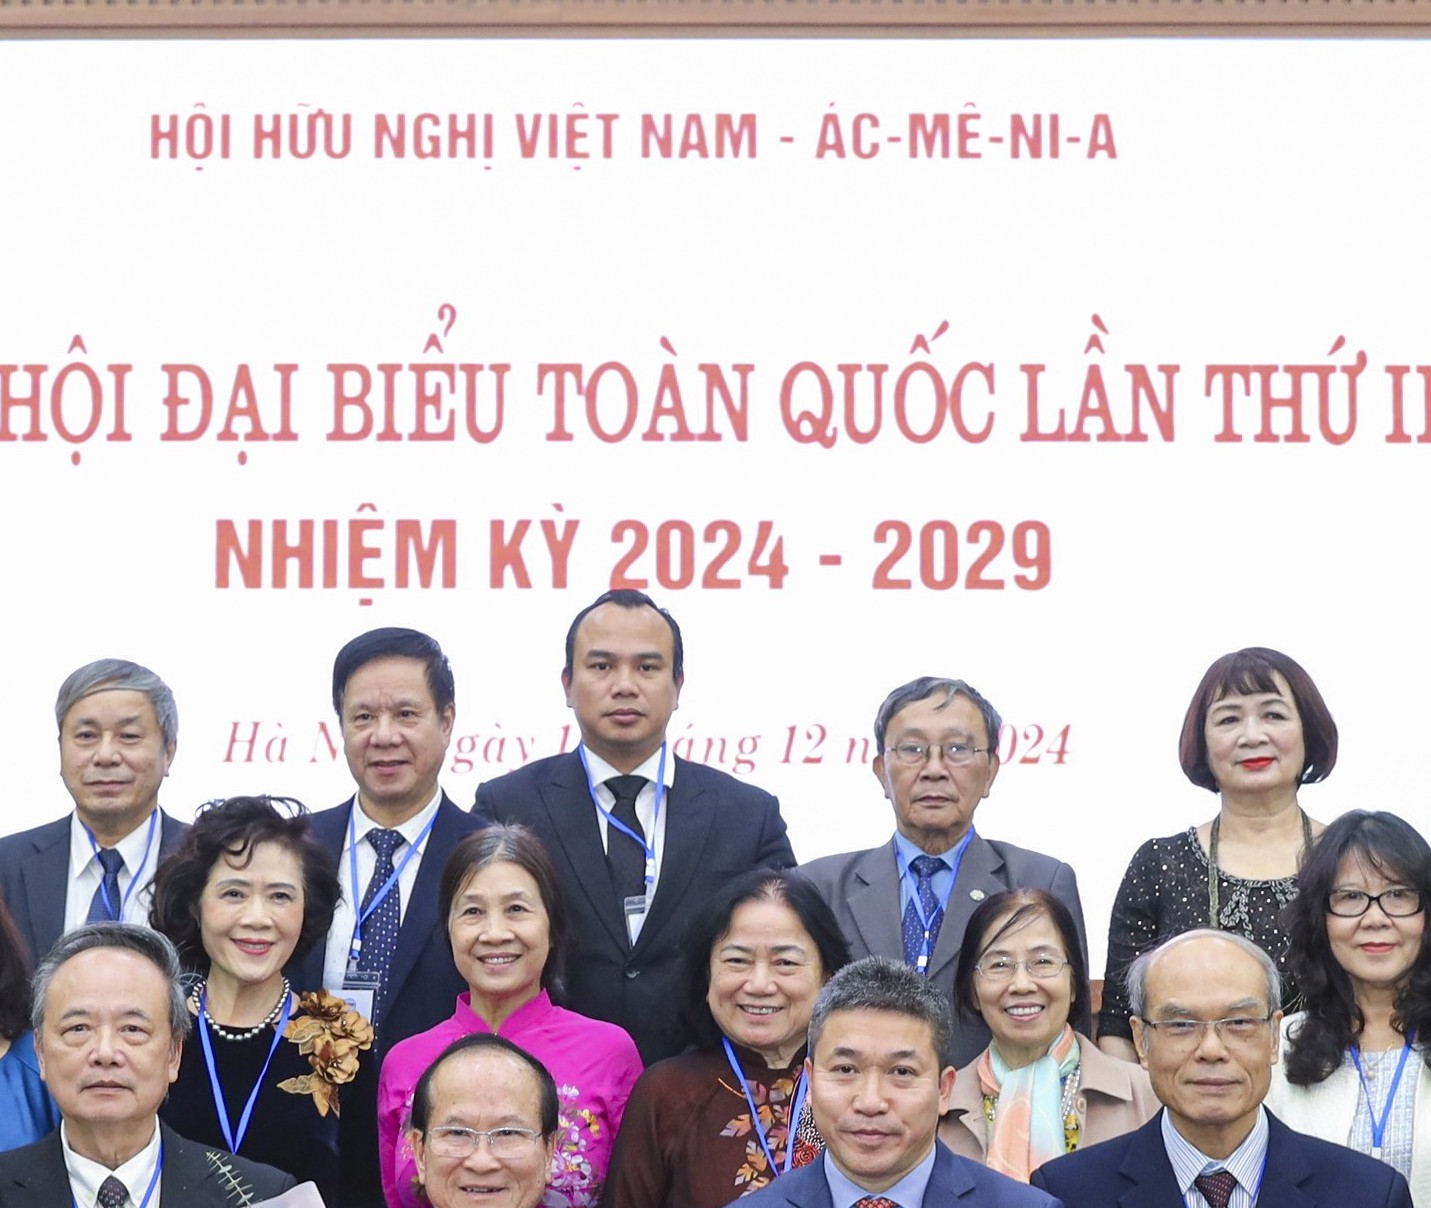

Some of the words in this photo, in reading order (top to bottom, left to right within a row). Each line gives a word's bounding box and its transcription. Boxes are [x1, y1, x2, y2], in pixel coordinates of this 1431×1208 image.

[150, 102, 232, 172] HỘI
[253, 102, 353, 160] HỮU
[374, 112, 494, 171] NGHỊ
[515, 102, 620, 171] VIỆT
[641, 112, 758, 160] NAM
[779, 135, 795, 144] -
[815, 101, 1119, 161] ÁC-MÊ-NI-A
[159, 362, 300, 466] ĐẠI
[326, 302, 512, 445] BIỂU
[536, 335, 756, 445] TOÀN
[778, 319, 996, 450] QUỐC
[1018, 312, 1182, 444] LẦN
[1203, 334, 1369, 447] THỨ
[214, 502, 458, 608] NHIỆM
[489, 502, 581, 590] KỲ
[609, 518, 790, 591] 2024
[818, 553, 843, 567] -
[871, 518, 1053, 592] 2029
[222, 722, 289, 764] Hà
[450, 723, 535, 774] gày
[672, 723, 762, 775] áng
[779, 723, 828, 765] 12
[996, 723, 1071, 766] 024
